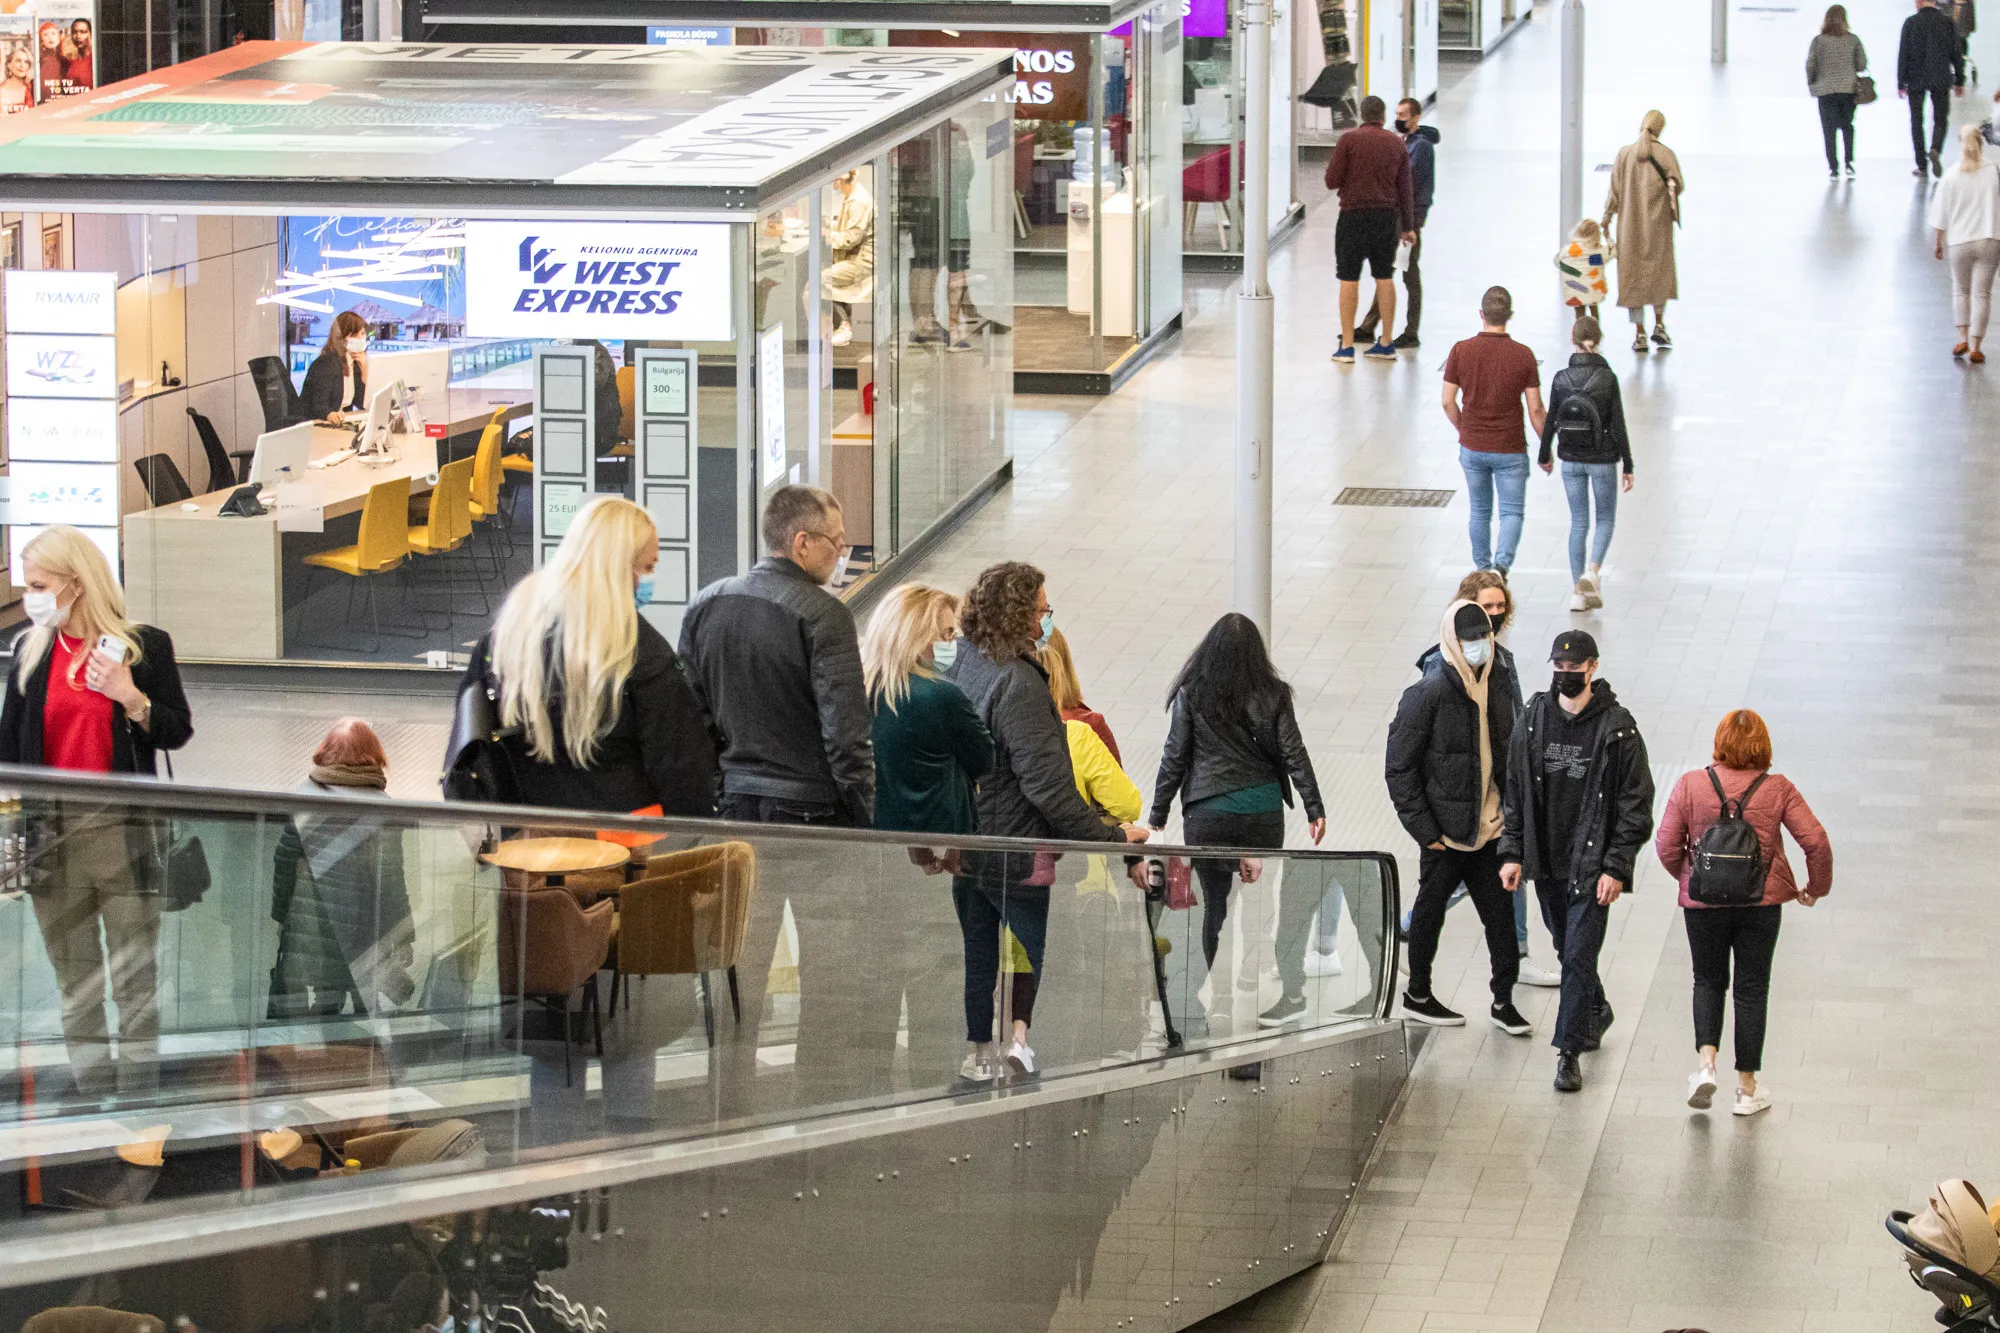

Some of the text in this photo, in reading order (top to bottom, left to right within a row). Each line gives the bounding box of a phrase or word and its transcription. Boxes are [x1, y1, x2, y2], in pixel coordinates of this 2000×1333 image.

[1013, 49, 1076, 74] NOS
[62, 79, 74, 87] TU
[50, 86, 91, 94] TO VERTA
[574, 261, 682, 285] WEST
[35, 291, 101, 304] RYANAIR
[513, 289, 683, 315] EXPRESS
[652, 366, 685, 376] Bulgarija
[652, 384, 670, 393] 300
[548, 504, 560, 513] 25
